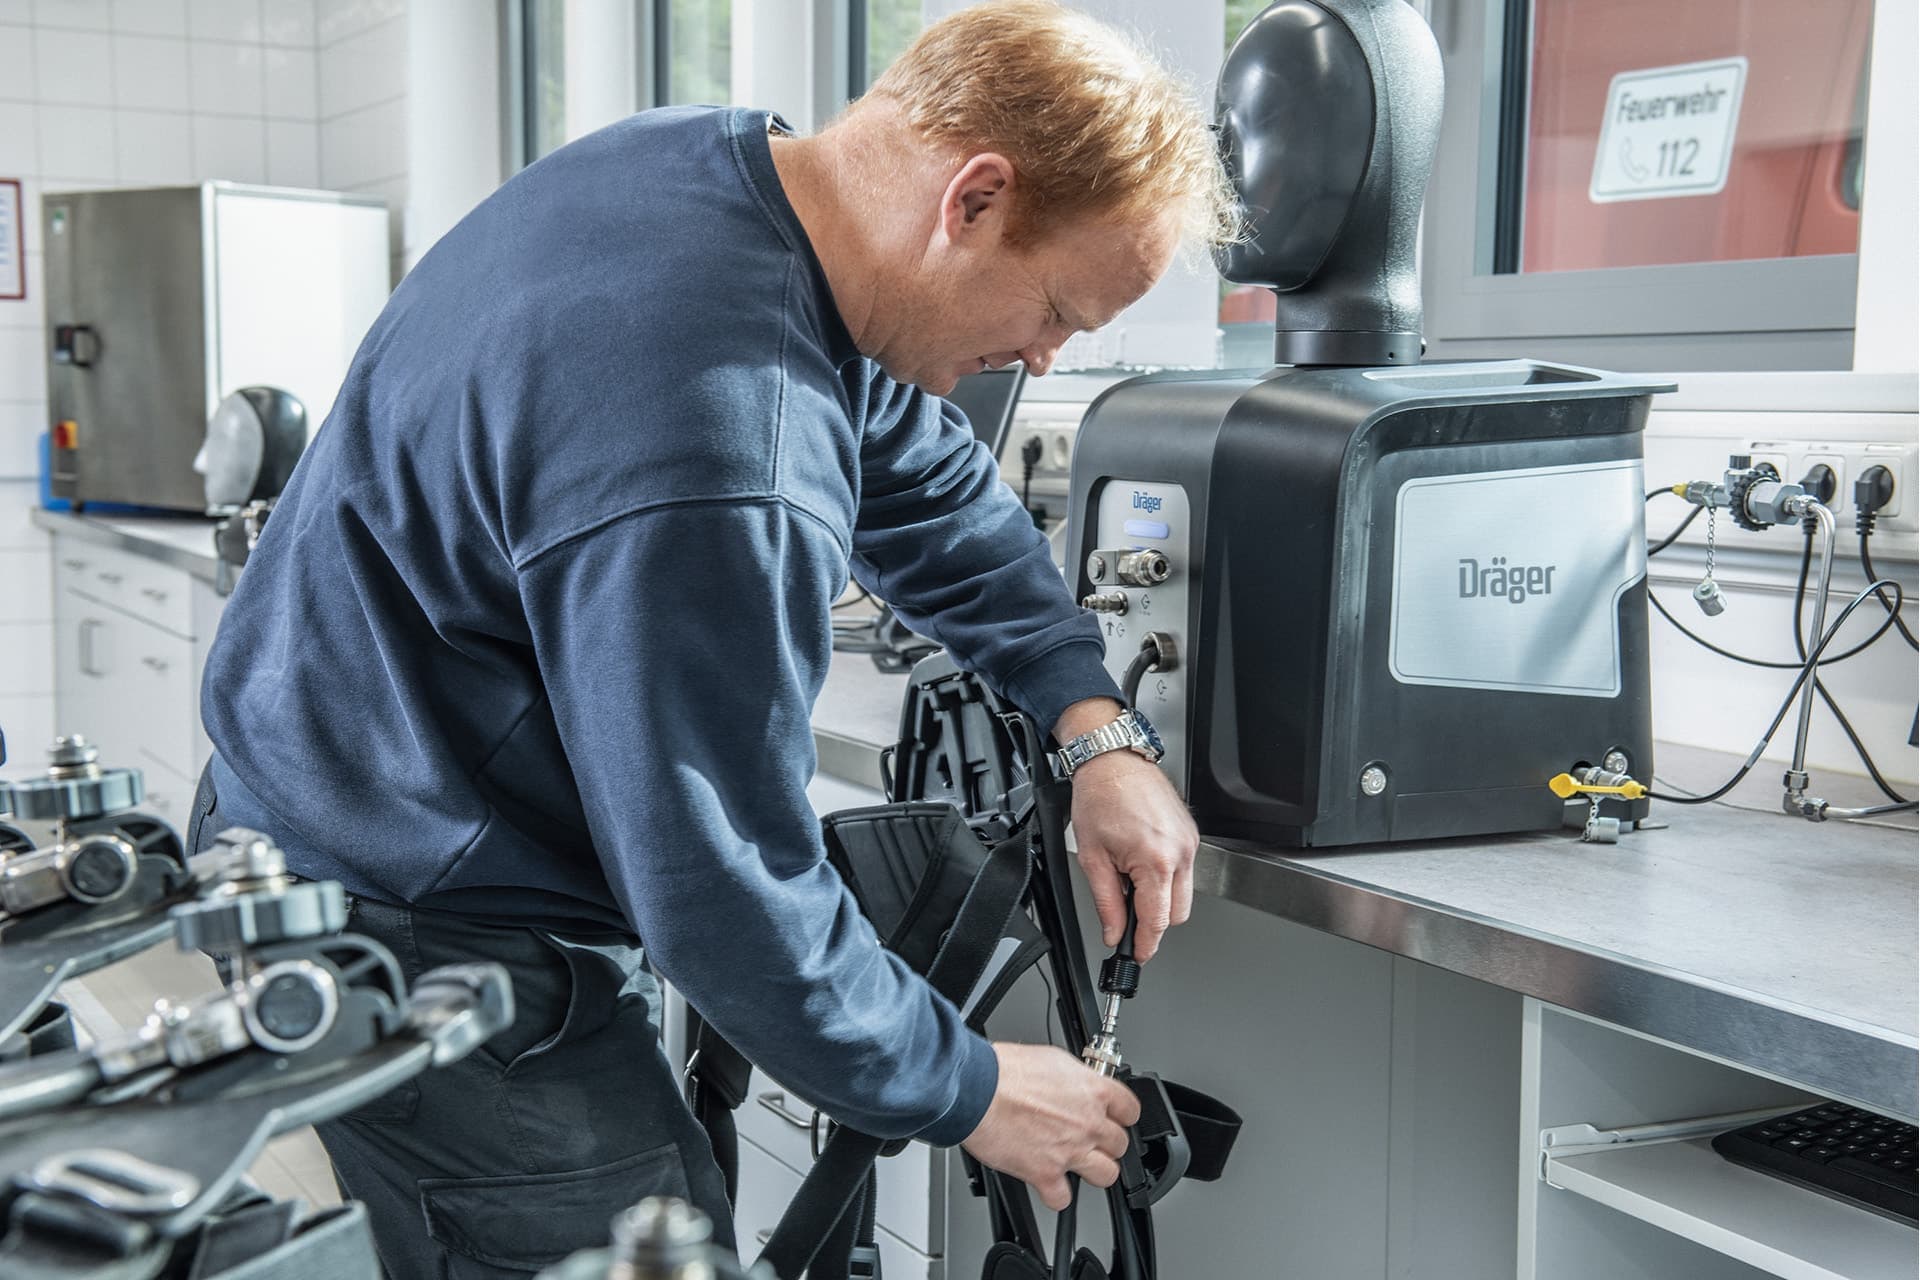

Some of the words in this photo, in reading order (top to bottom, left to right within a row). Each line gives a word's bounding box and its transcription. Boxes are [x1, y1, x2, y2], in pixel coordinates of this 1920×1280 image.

[1617, 83, 1727, 124] Feuerwehr
[1657, 138, 1701, 177] 112
[1133, 491, 1162, 513] Dräger
[1459, 557, 1556, 604] Dräger
